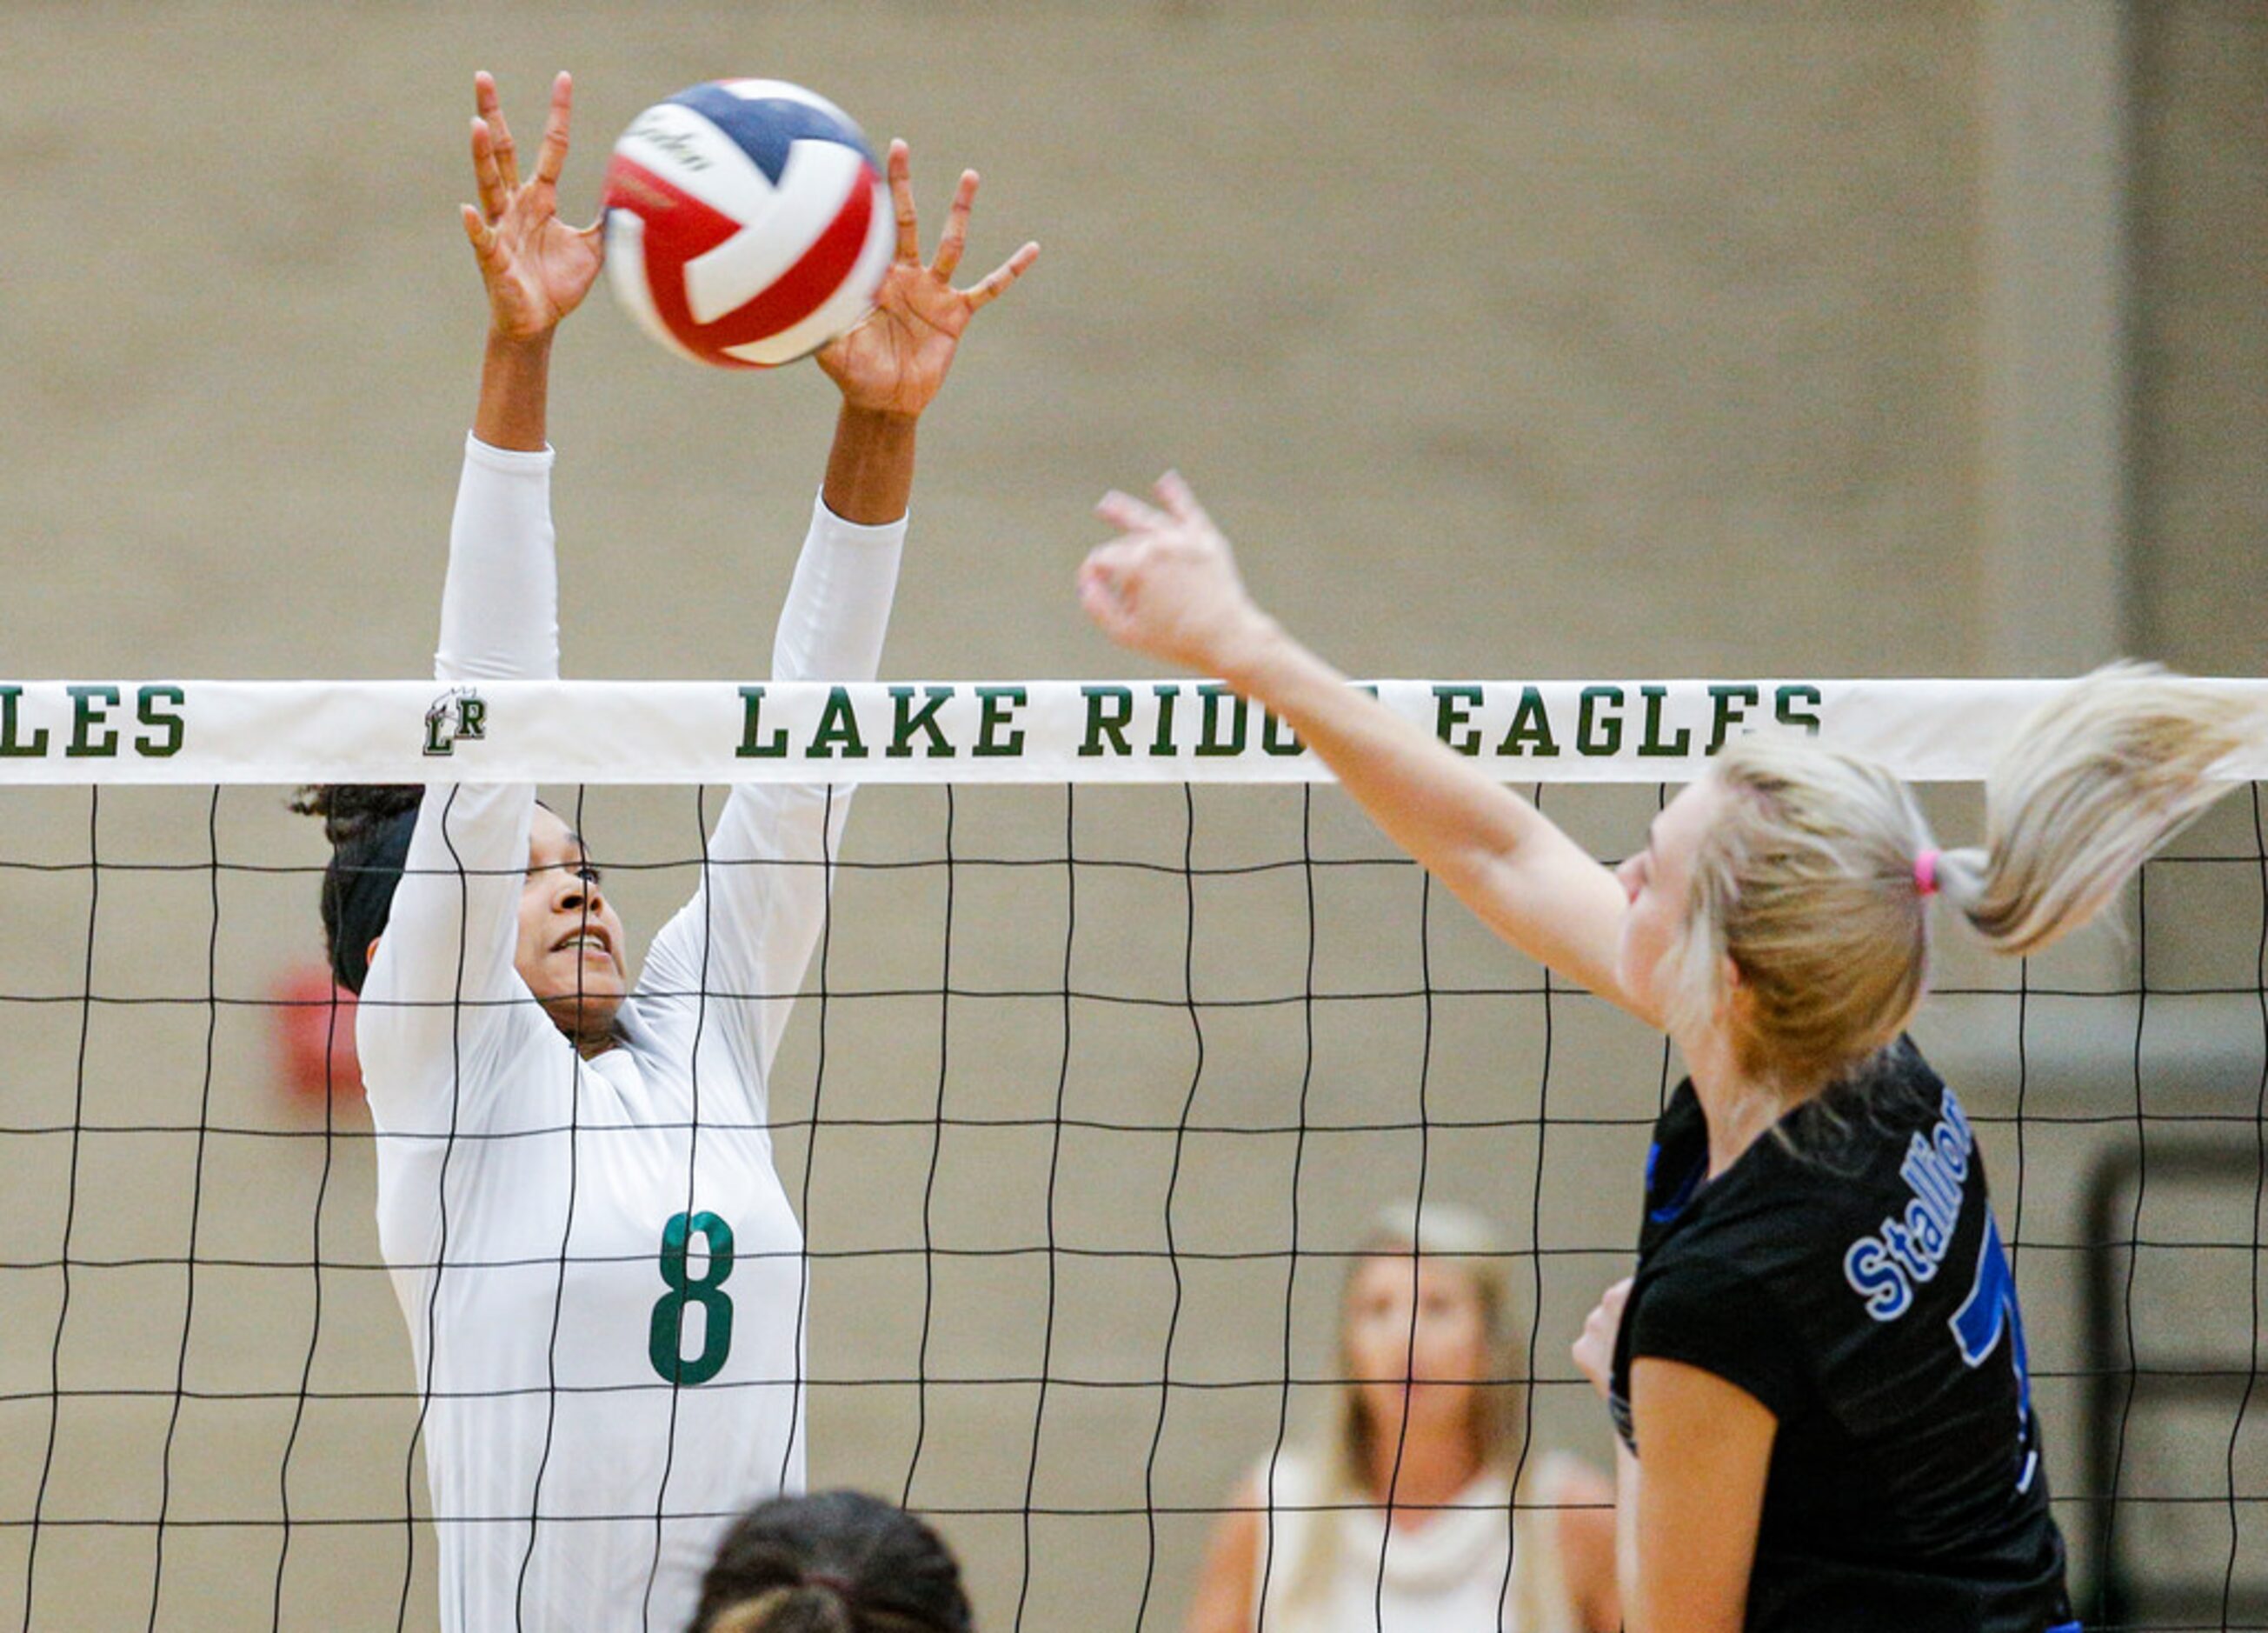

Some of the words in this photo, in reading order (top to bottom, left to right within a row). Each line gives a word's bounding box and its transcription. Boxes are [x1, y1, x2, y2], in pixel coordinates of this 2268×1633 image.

[0, 685, 186, 757] LES
[735, 685, 1028, 758] LAKE
[1077, 685, 1379, 757] RIDG
[648, 1210, 735, 1385] 8
